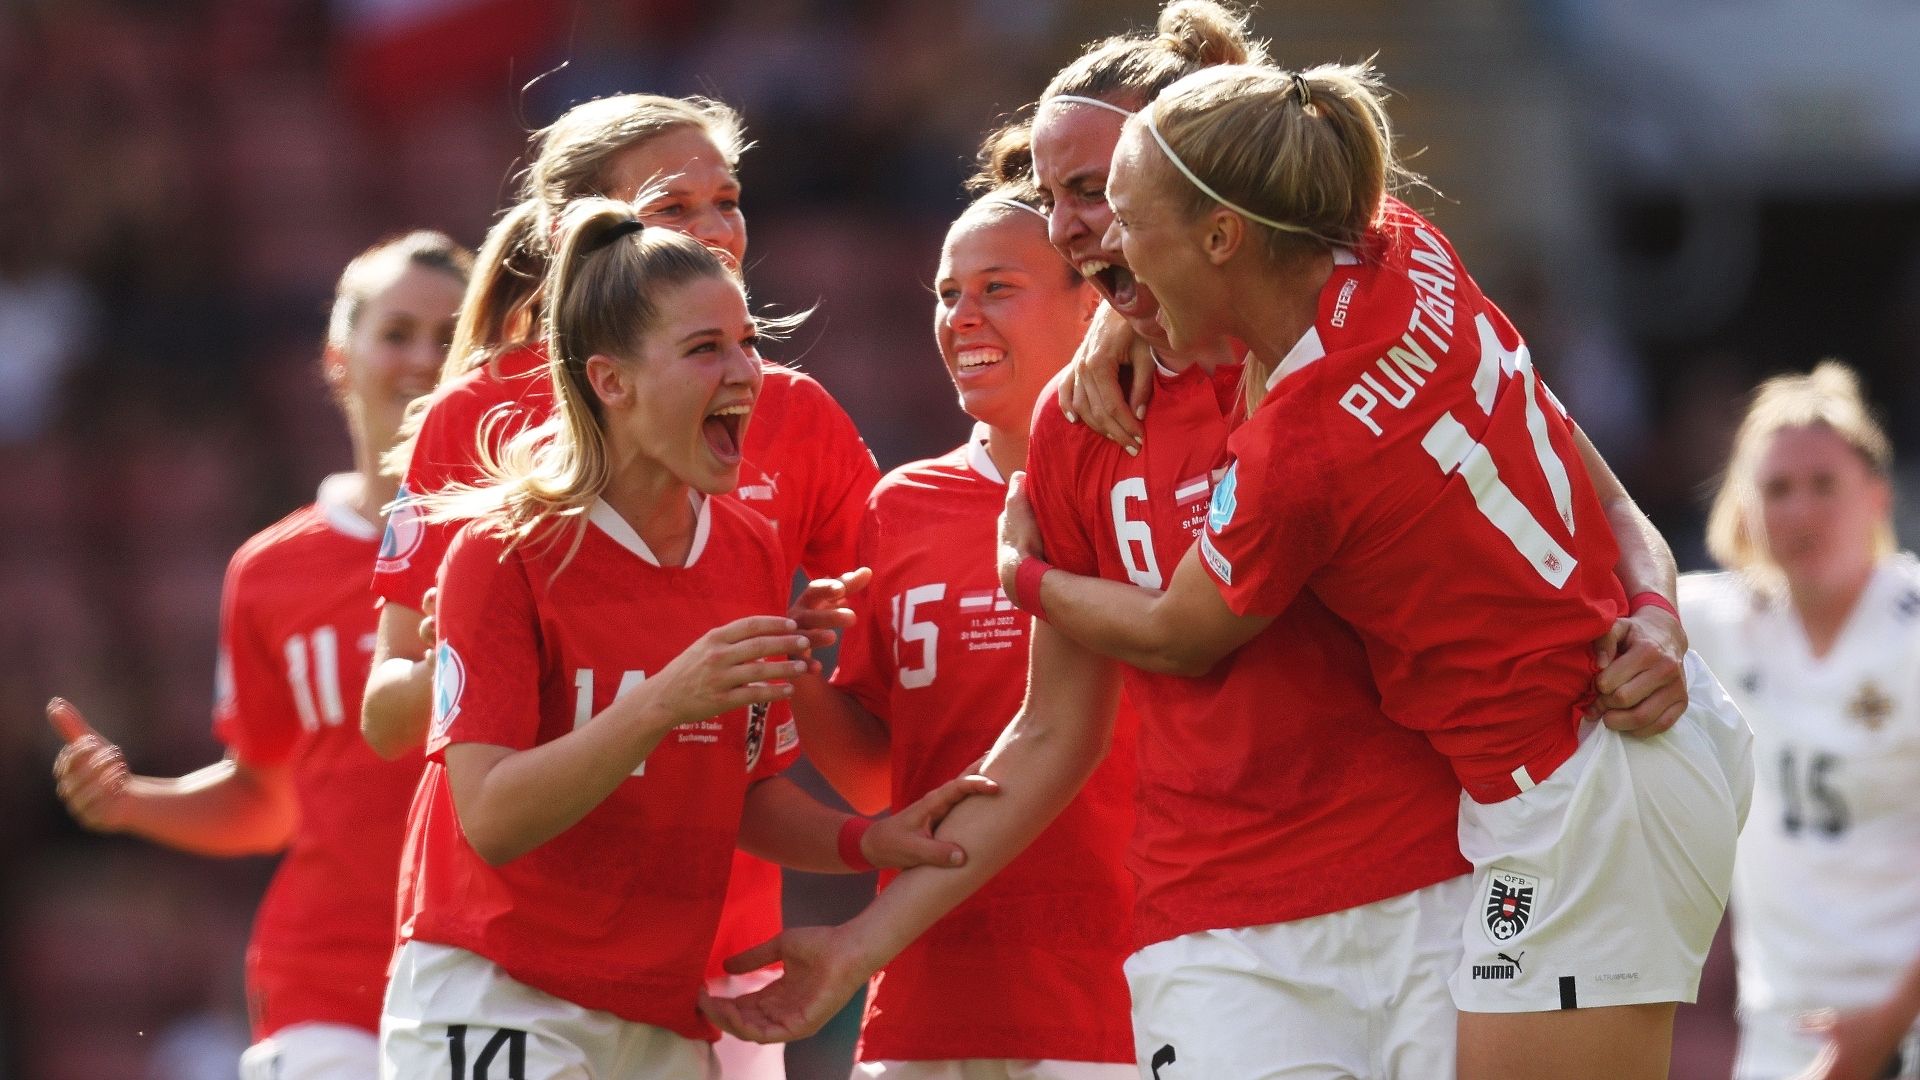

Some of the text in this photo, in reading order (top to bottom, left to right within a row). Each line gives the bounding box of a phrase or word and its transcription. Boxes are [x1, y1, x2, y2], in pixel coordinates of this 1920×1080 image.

[1339, 227, 1455, 437] PUNTIGAM
[1420, 312, 1578, 590] 17
[1110, 477, 1163, 589] 6
[284, 626, 346, 732] 11
[891, 583, 947, 690] 15
[1780, 741, 1851, 841] 15
[1503, 874, 1526, 886] ÖFB
[1472, 964, 1515, 980] PUMA
